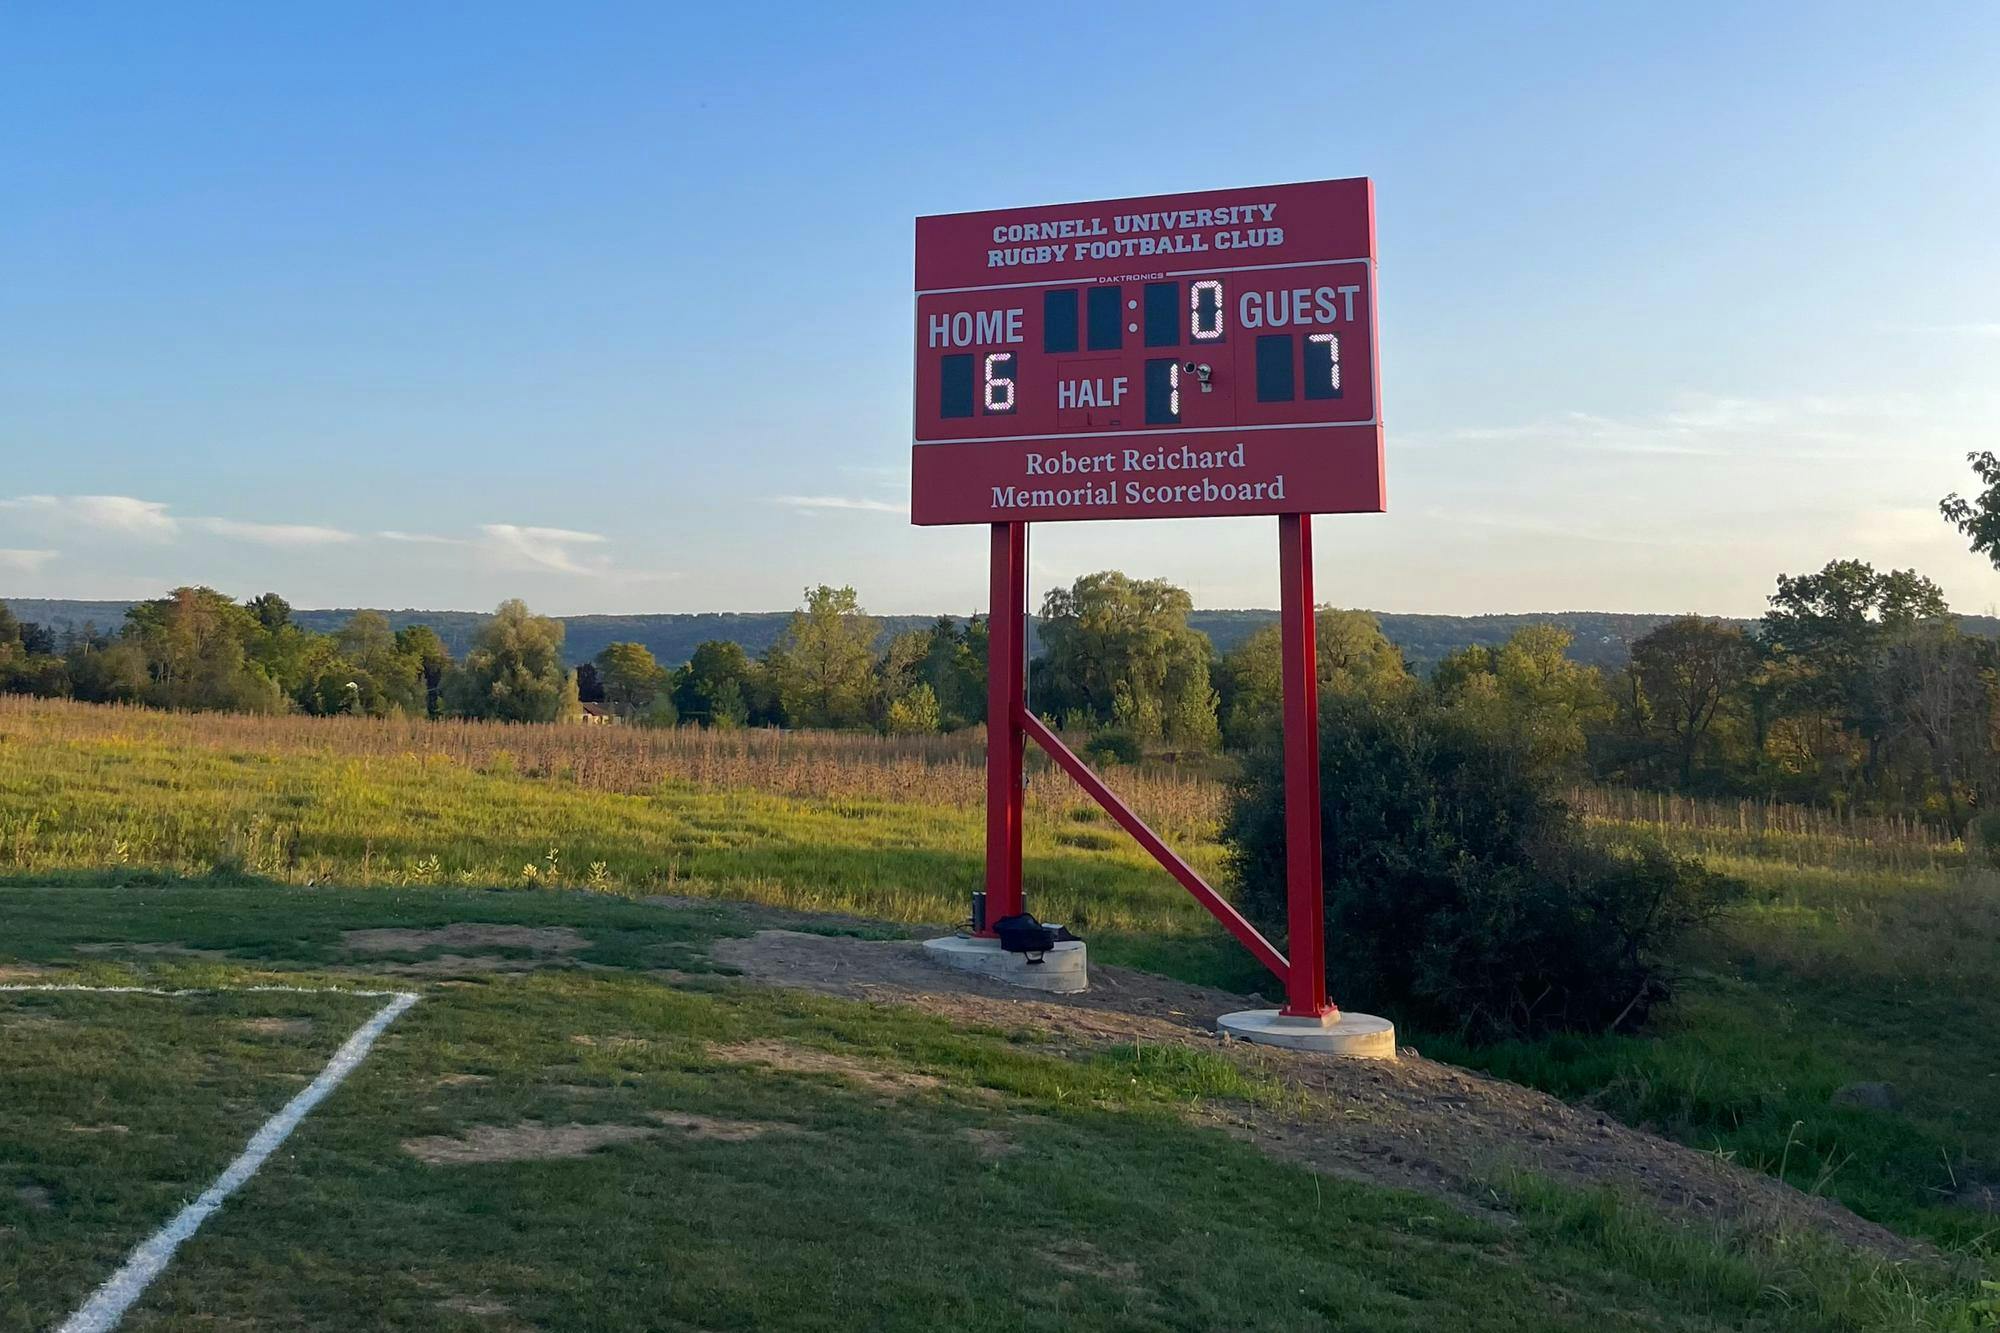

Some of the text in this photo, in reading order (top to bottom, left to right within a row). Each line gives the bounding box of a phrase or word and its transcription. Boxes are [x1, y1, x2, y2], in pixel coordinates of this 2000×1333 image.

[993, 203, 1277, 243] CORNELL UNIVERSITY
[987, 227, 1285, 268] RUGBY FOOTBALL CLUB
[1098, 272, 1165, 284] DAKTRONICS
[1191, 280, 1223, 339] 0
[1239, 285, 1361, 329] GUEST
[928, 308, 1025, 348] HOME
[984, 352, 1015, 411] 6
[1308, 333, 1340, 391] 7
[1057, 376, 1128, 410] HALF
[1025, 443, 1246, 475] Robert Reichard
[990, 475, 1286, 508] Memorial Scoreboard
